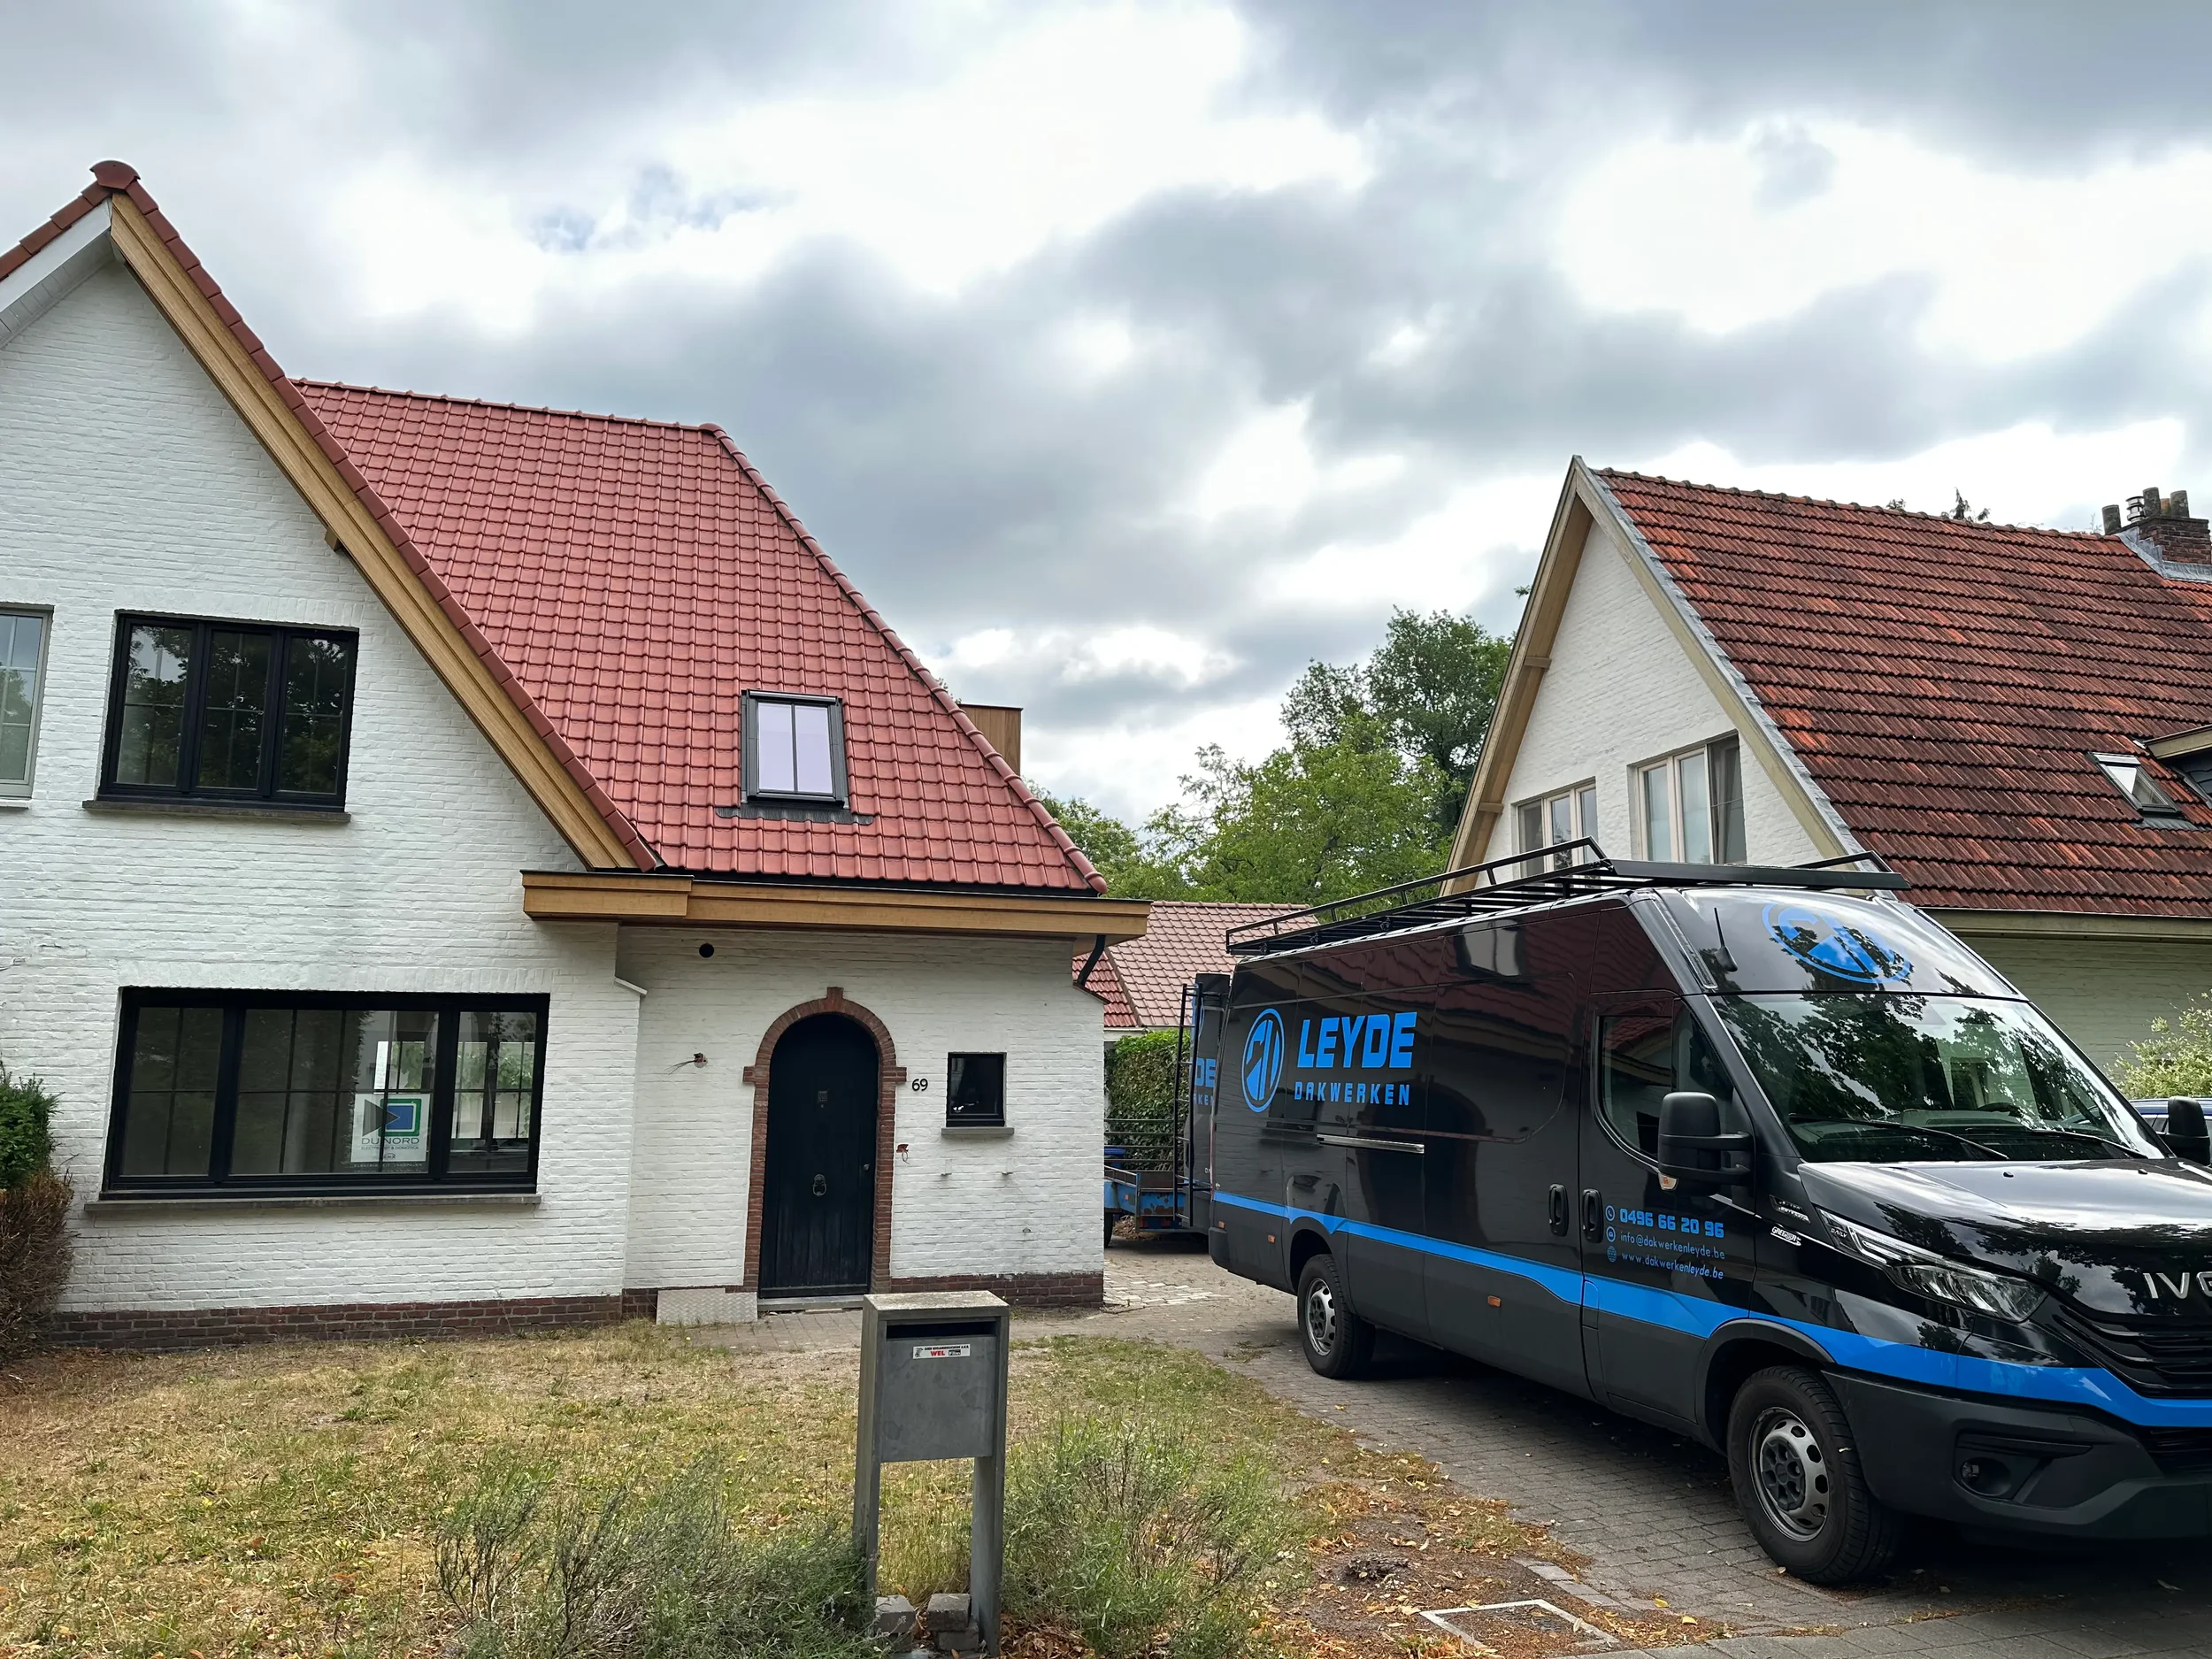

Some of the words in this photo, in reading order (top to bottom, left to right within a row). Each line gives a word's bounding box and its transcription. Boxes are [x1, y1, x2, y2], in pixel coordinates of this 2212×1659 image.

[1297, 1011, 1417, 1068] LEYDE
[911, 1078, 928, 1091] 69
[1194, 1057, 1217, 1088] DE
[1294, 1081, 1409, 1106] DAKWERKEN
[1620, 1209, 1654, 1227] 0496
[1658, 1214, 1676, 1230] 66
[1681, 1217, 1699, 1234] 20
[1704, 1221, 1724, 1238] 96
[1831, 1227, 1847, 1239] DAILY
[1621, 1232, 1725, 1259] info@dakwerkenleyde.be
[1622, 1252, 1724, 1279] www.dakwerkenleyde.be
